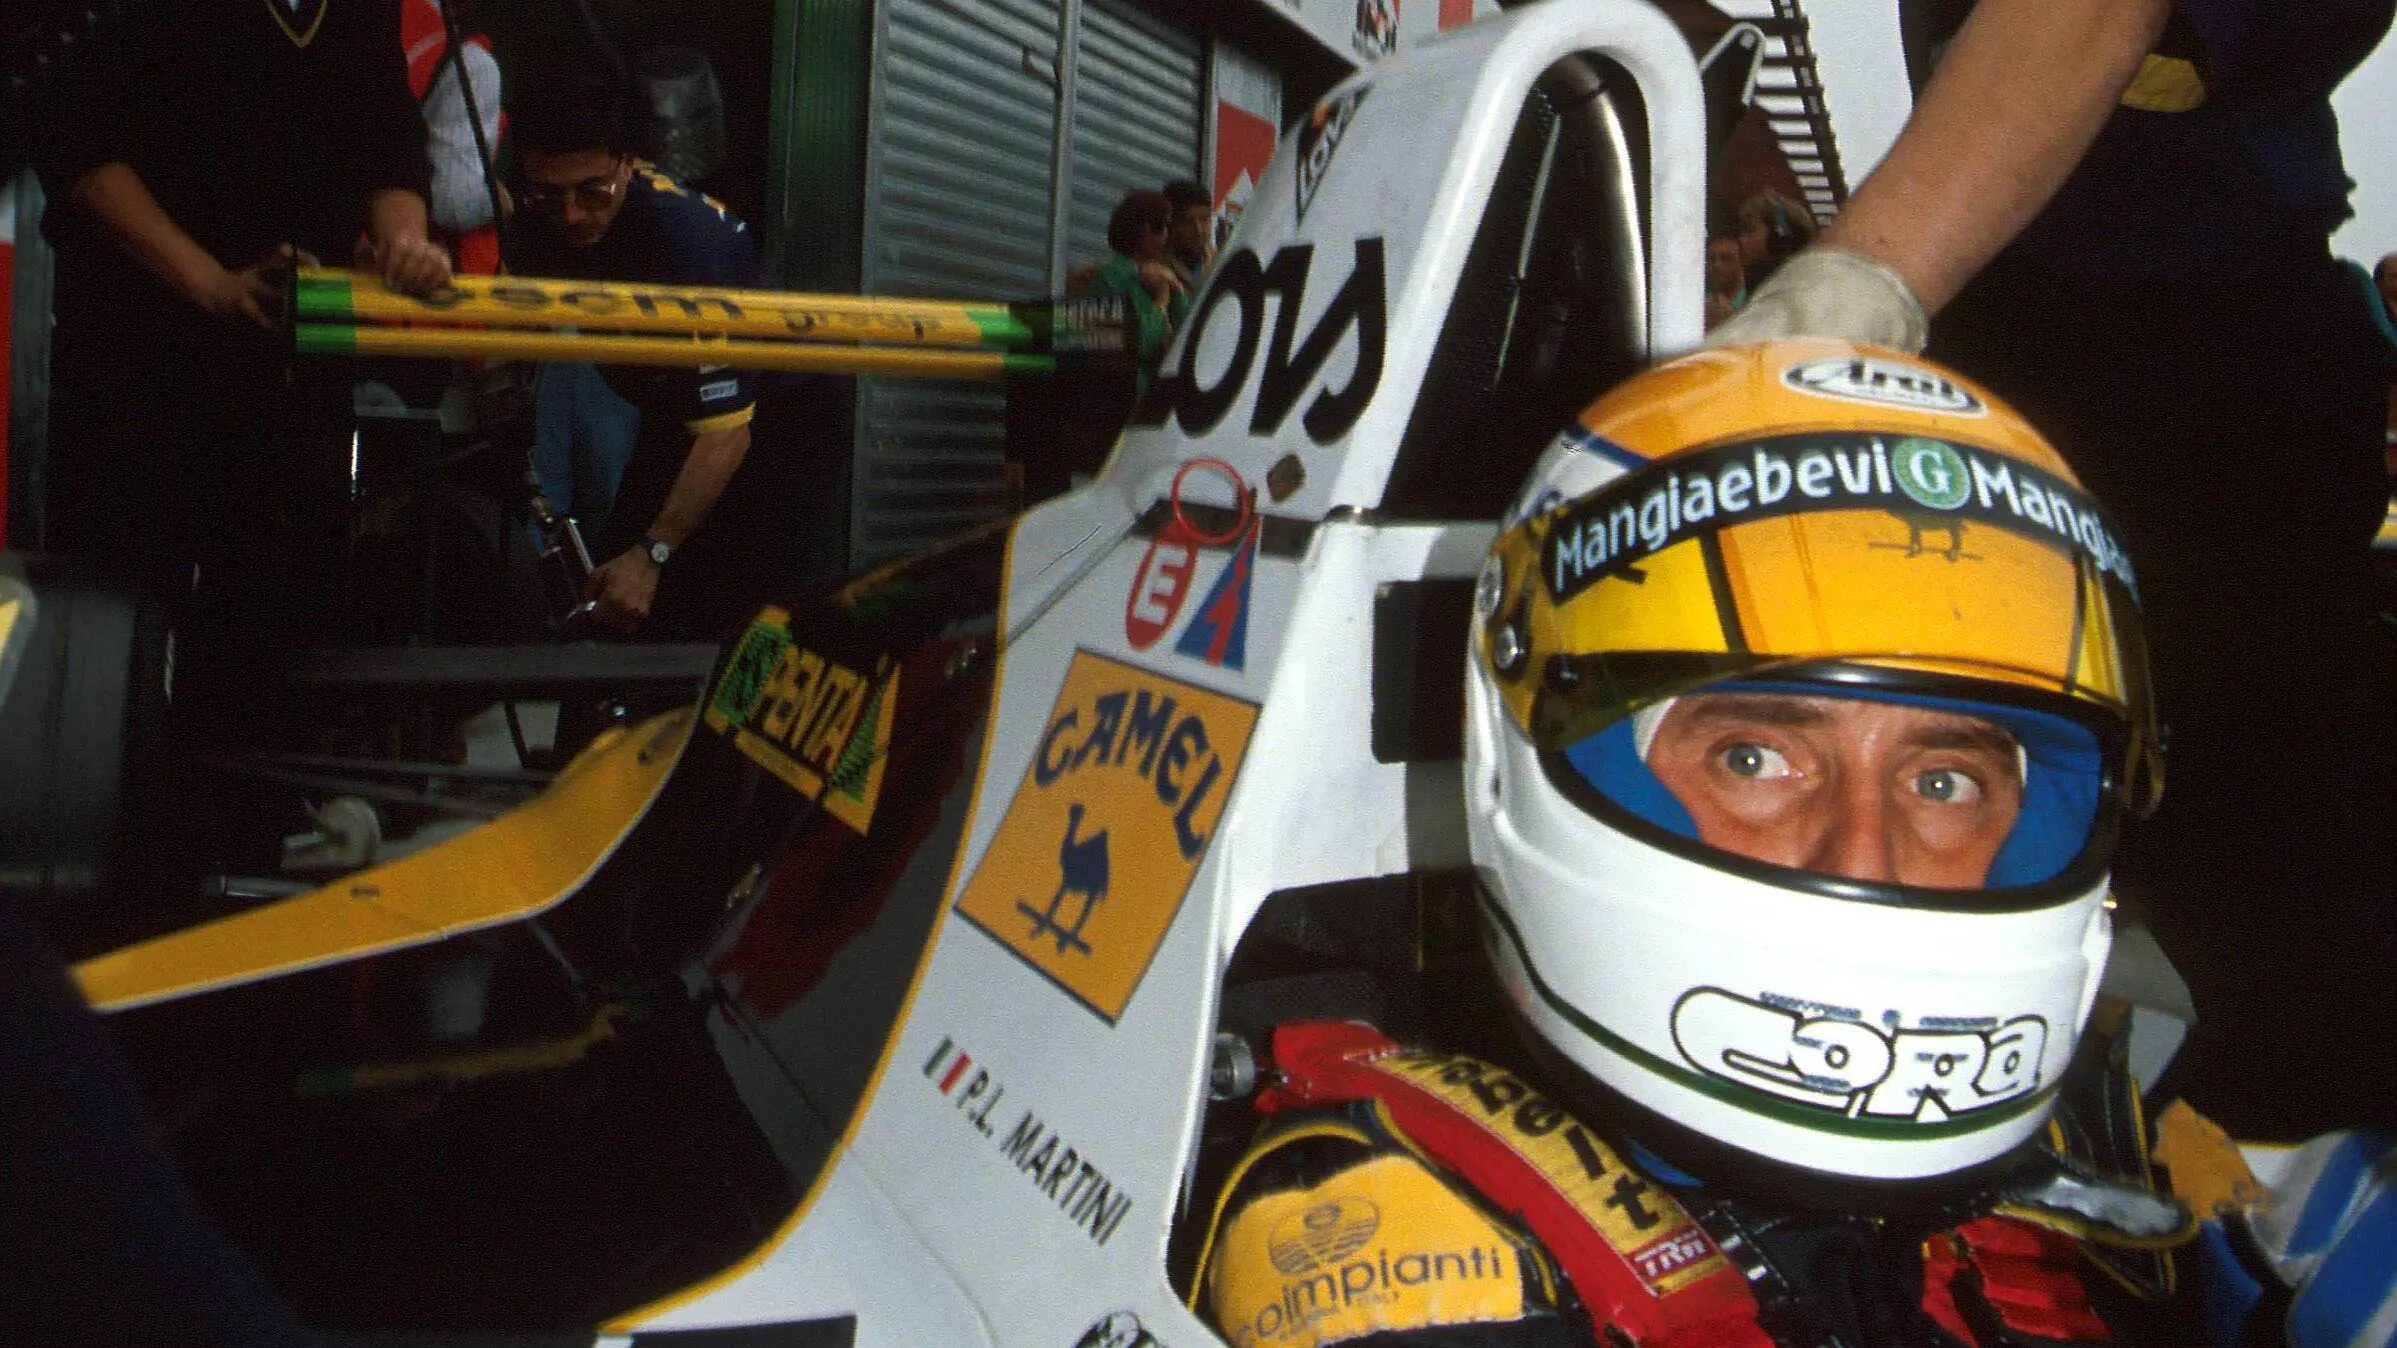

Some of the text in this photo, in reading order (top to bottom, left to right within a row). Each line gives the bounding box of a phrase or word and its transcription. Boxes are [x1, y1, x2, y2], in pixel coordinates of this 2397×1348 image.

[1555, 437, 1892, 595] Mangiaebevi
[1034, 689, 1222, 862] CAMEL
[955, 1066, 1134, 1247] P.L. MARTINI
